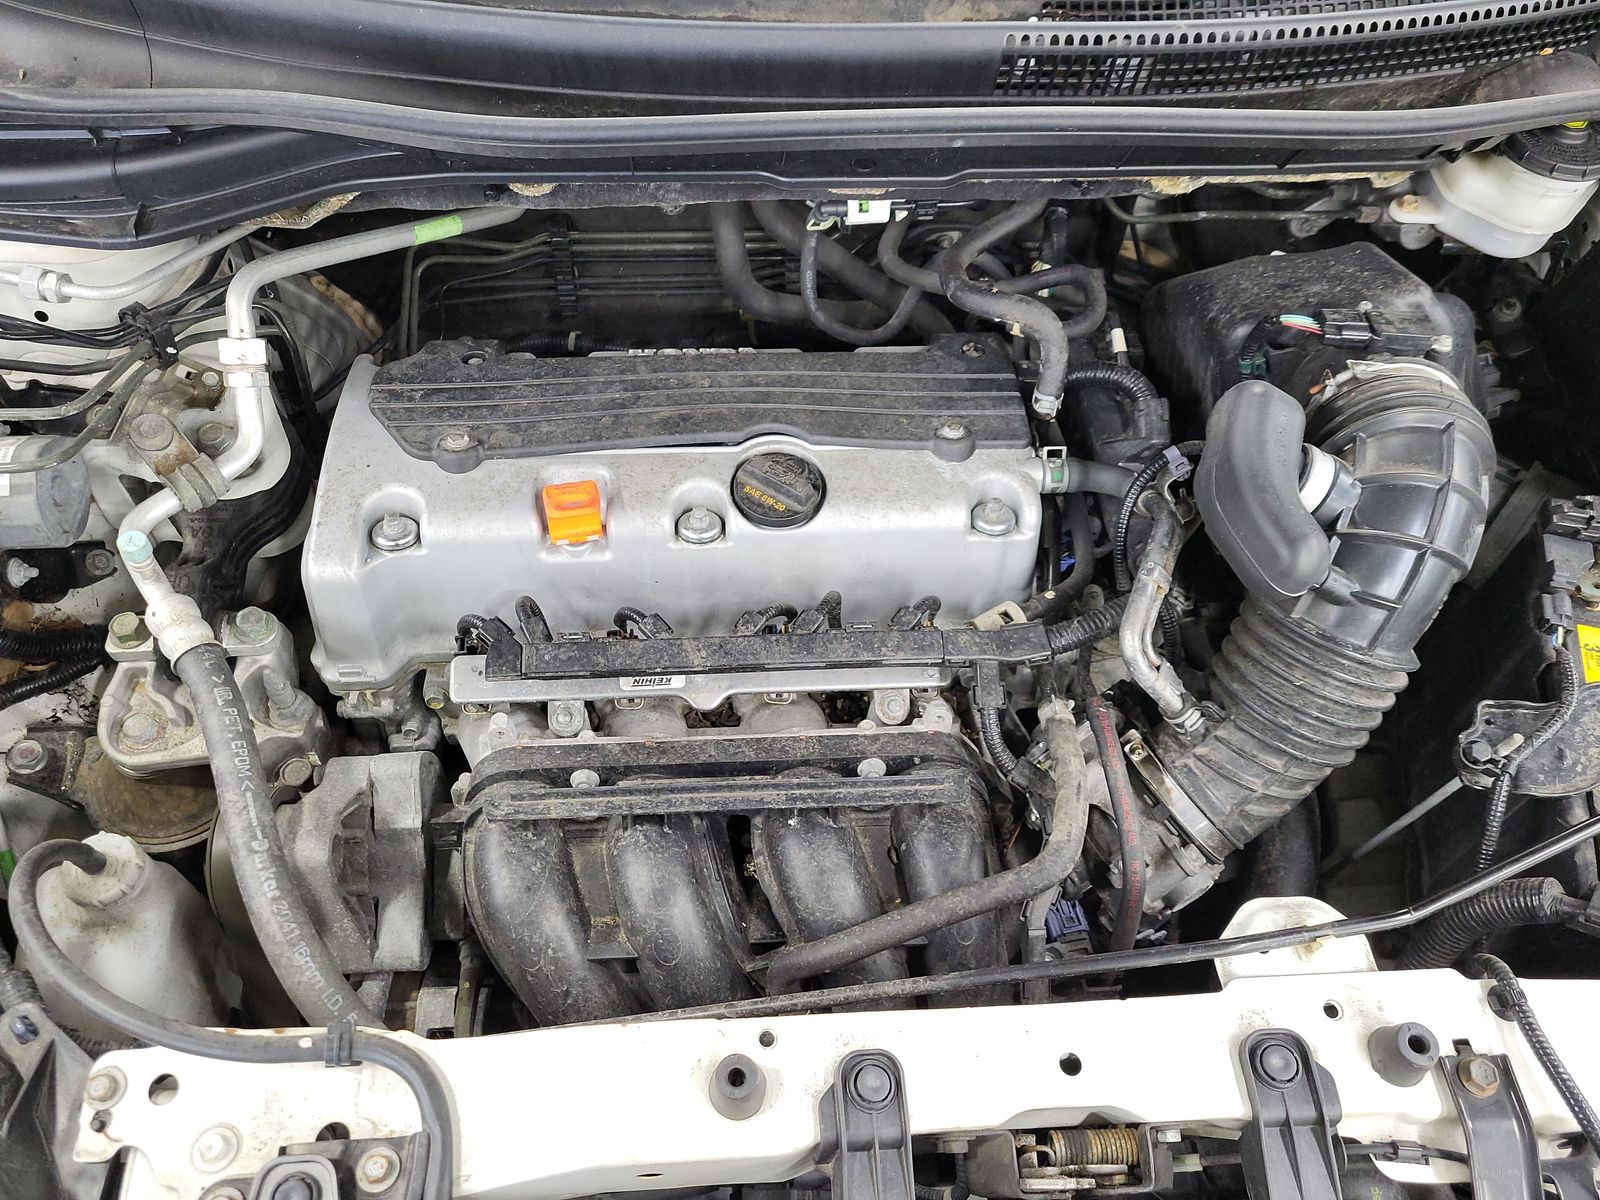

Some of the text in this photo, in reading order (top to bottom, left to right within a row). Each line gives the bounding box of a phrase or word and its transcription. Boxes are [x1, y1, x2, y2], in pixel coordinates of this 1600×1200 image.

[744, 485, 786, 511] SAE 0W-20
[631, 676, 672, 688] KEIHIN
[272, 900, 300, 939] 2041
[293, 941, 325, 989] 16mm
